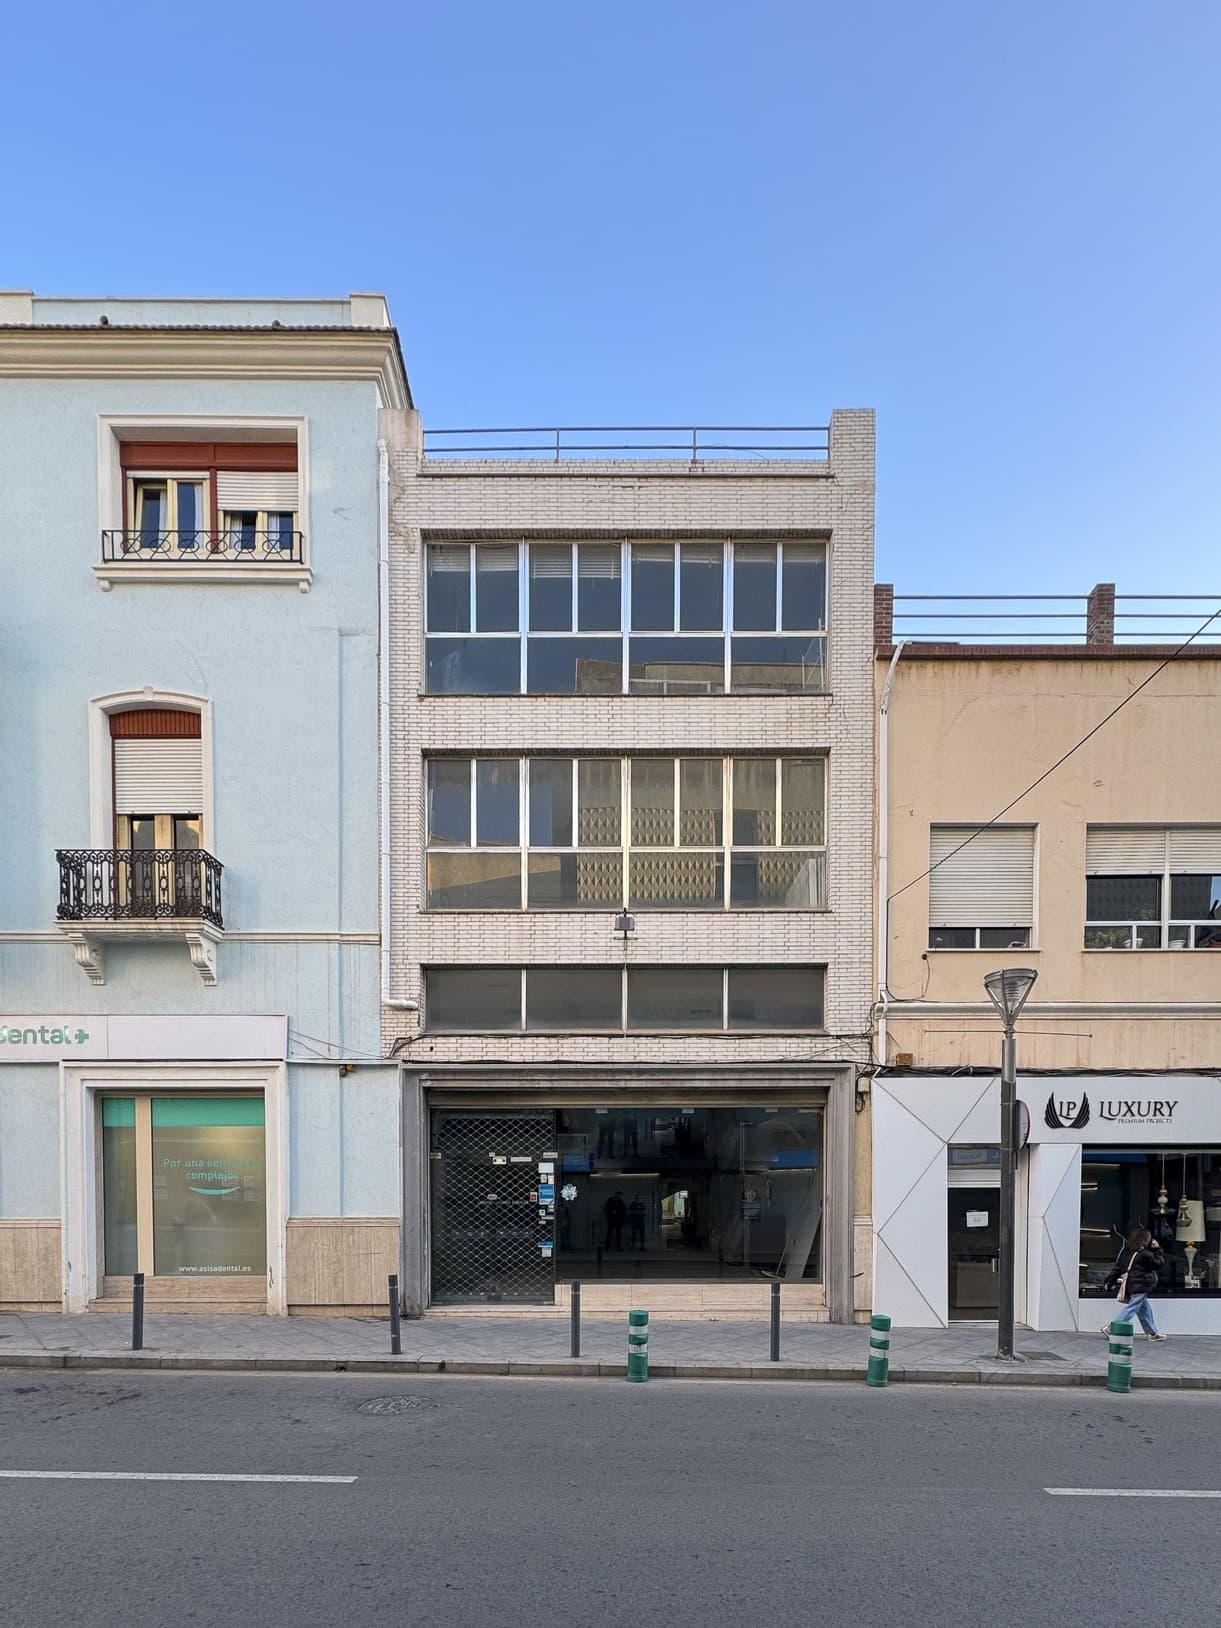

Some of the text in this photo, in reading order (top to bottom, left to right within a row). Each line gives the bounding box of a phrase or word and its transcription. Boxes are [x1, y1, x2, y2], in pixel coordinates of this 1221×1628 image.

[1099, 1101, 1179, 1120] LUXURY
[163, 1158, 181, 1168] Por
[185, 1159, 205, 1168] una
[207, 1159, 247, 1168] sona
